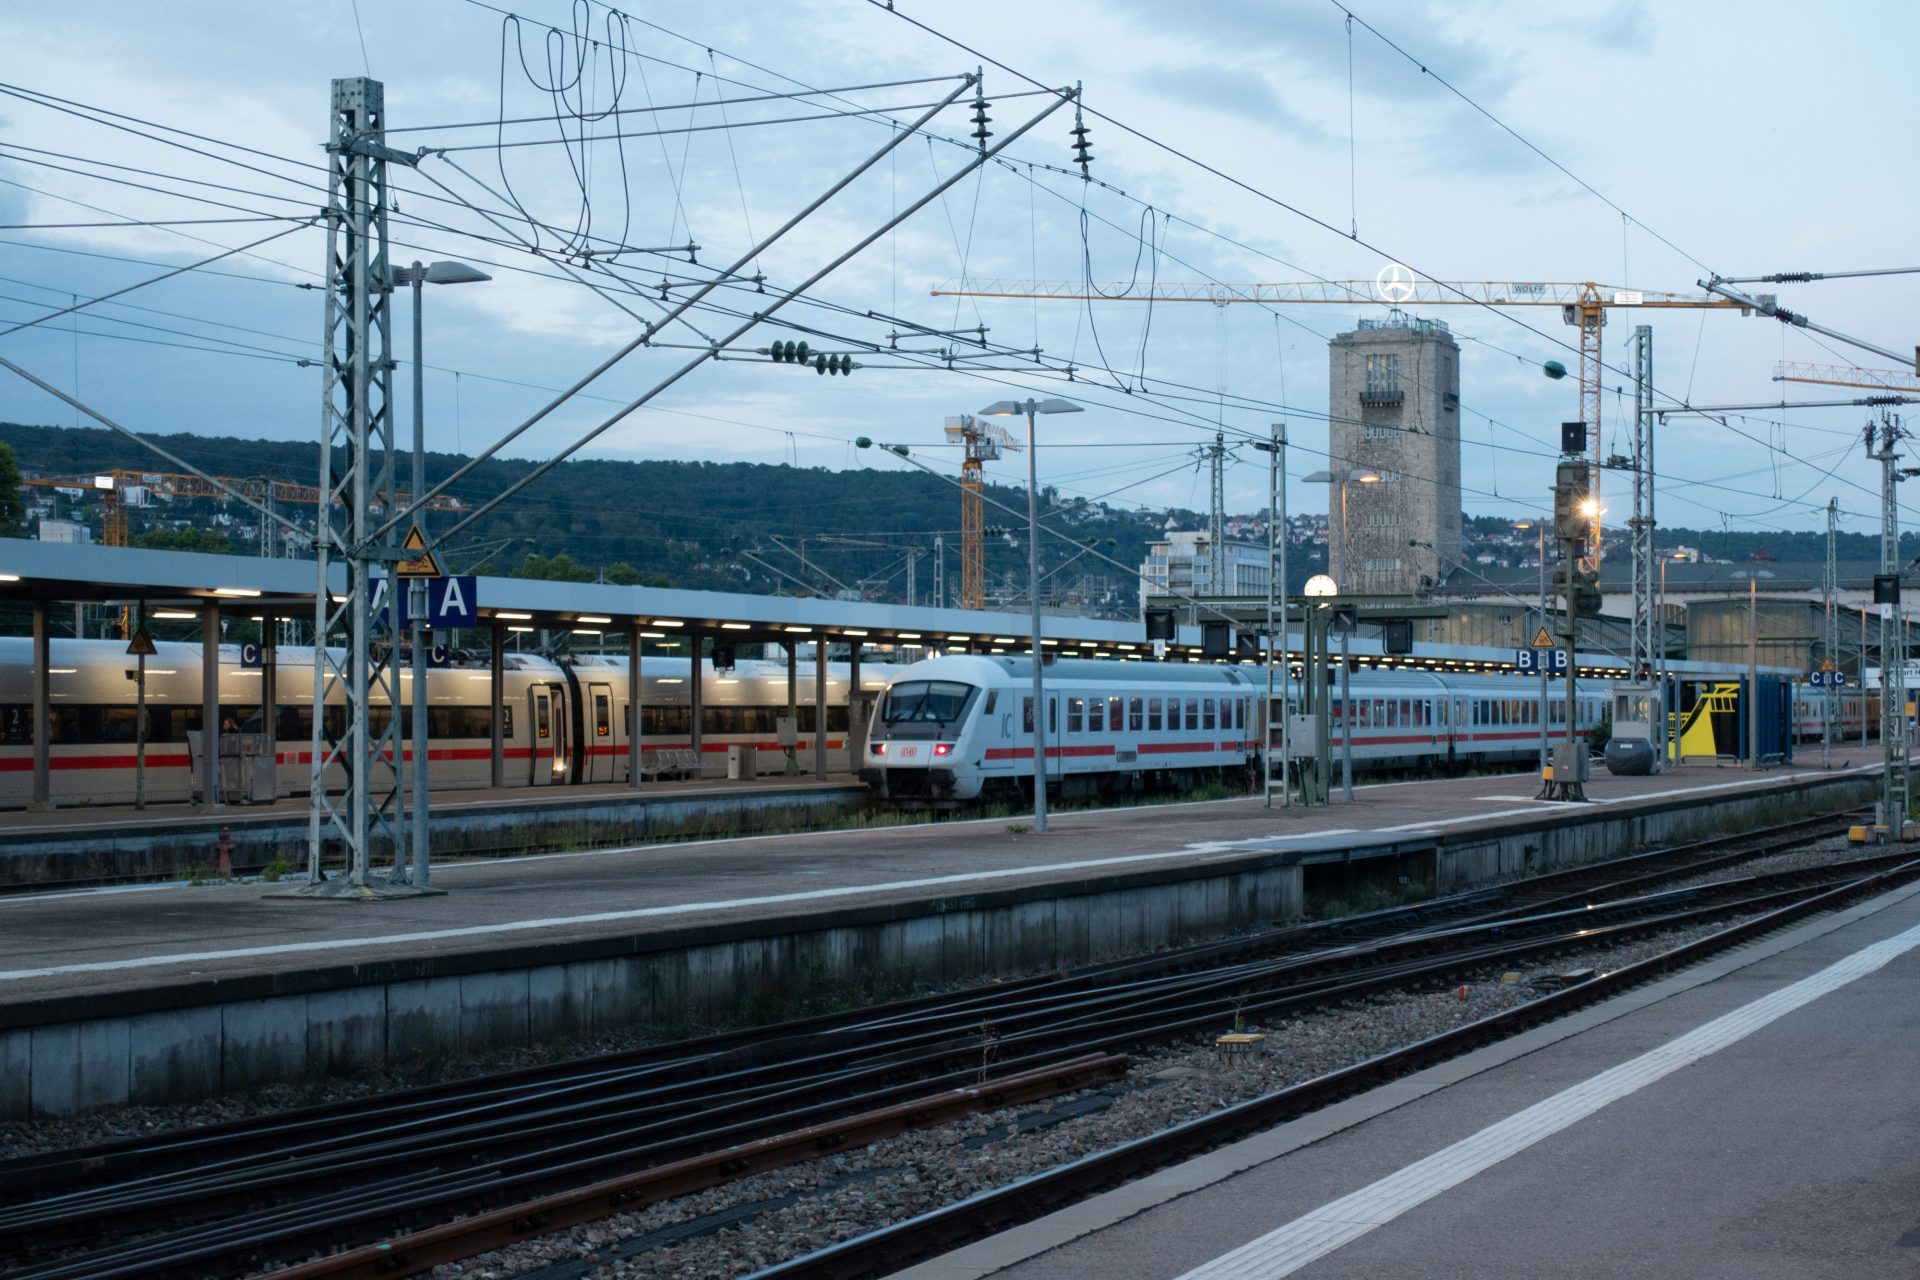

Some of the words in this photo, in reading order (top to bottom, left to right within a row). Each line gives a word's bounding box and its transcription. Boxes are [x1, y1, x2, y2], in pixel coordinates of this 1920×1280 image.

[1514, 285, 1544, 293] WOLFF
[439, 578, 468, 616] A
[243, 644, 256, 663] C
[432, 645, 445, 663] C
[1519, 651, 1532, 668] B
[1555, 650, 1567, 668] B
[1811, 672, 1820, 684] C
[1834, 672, 1844, 683] C
[1001, 713, 1012, 739] IC
